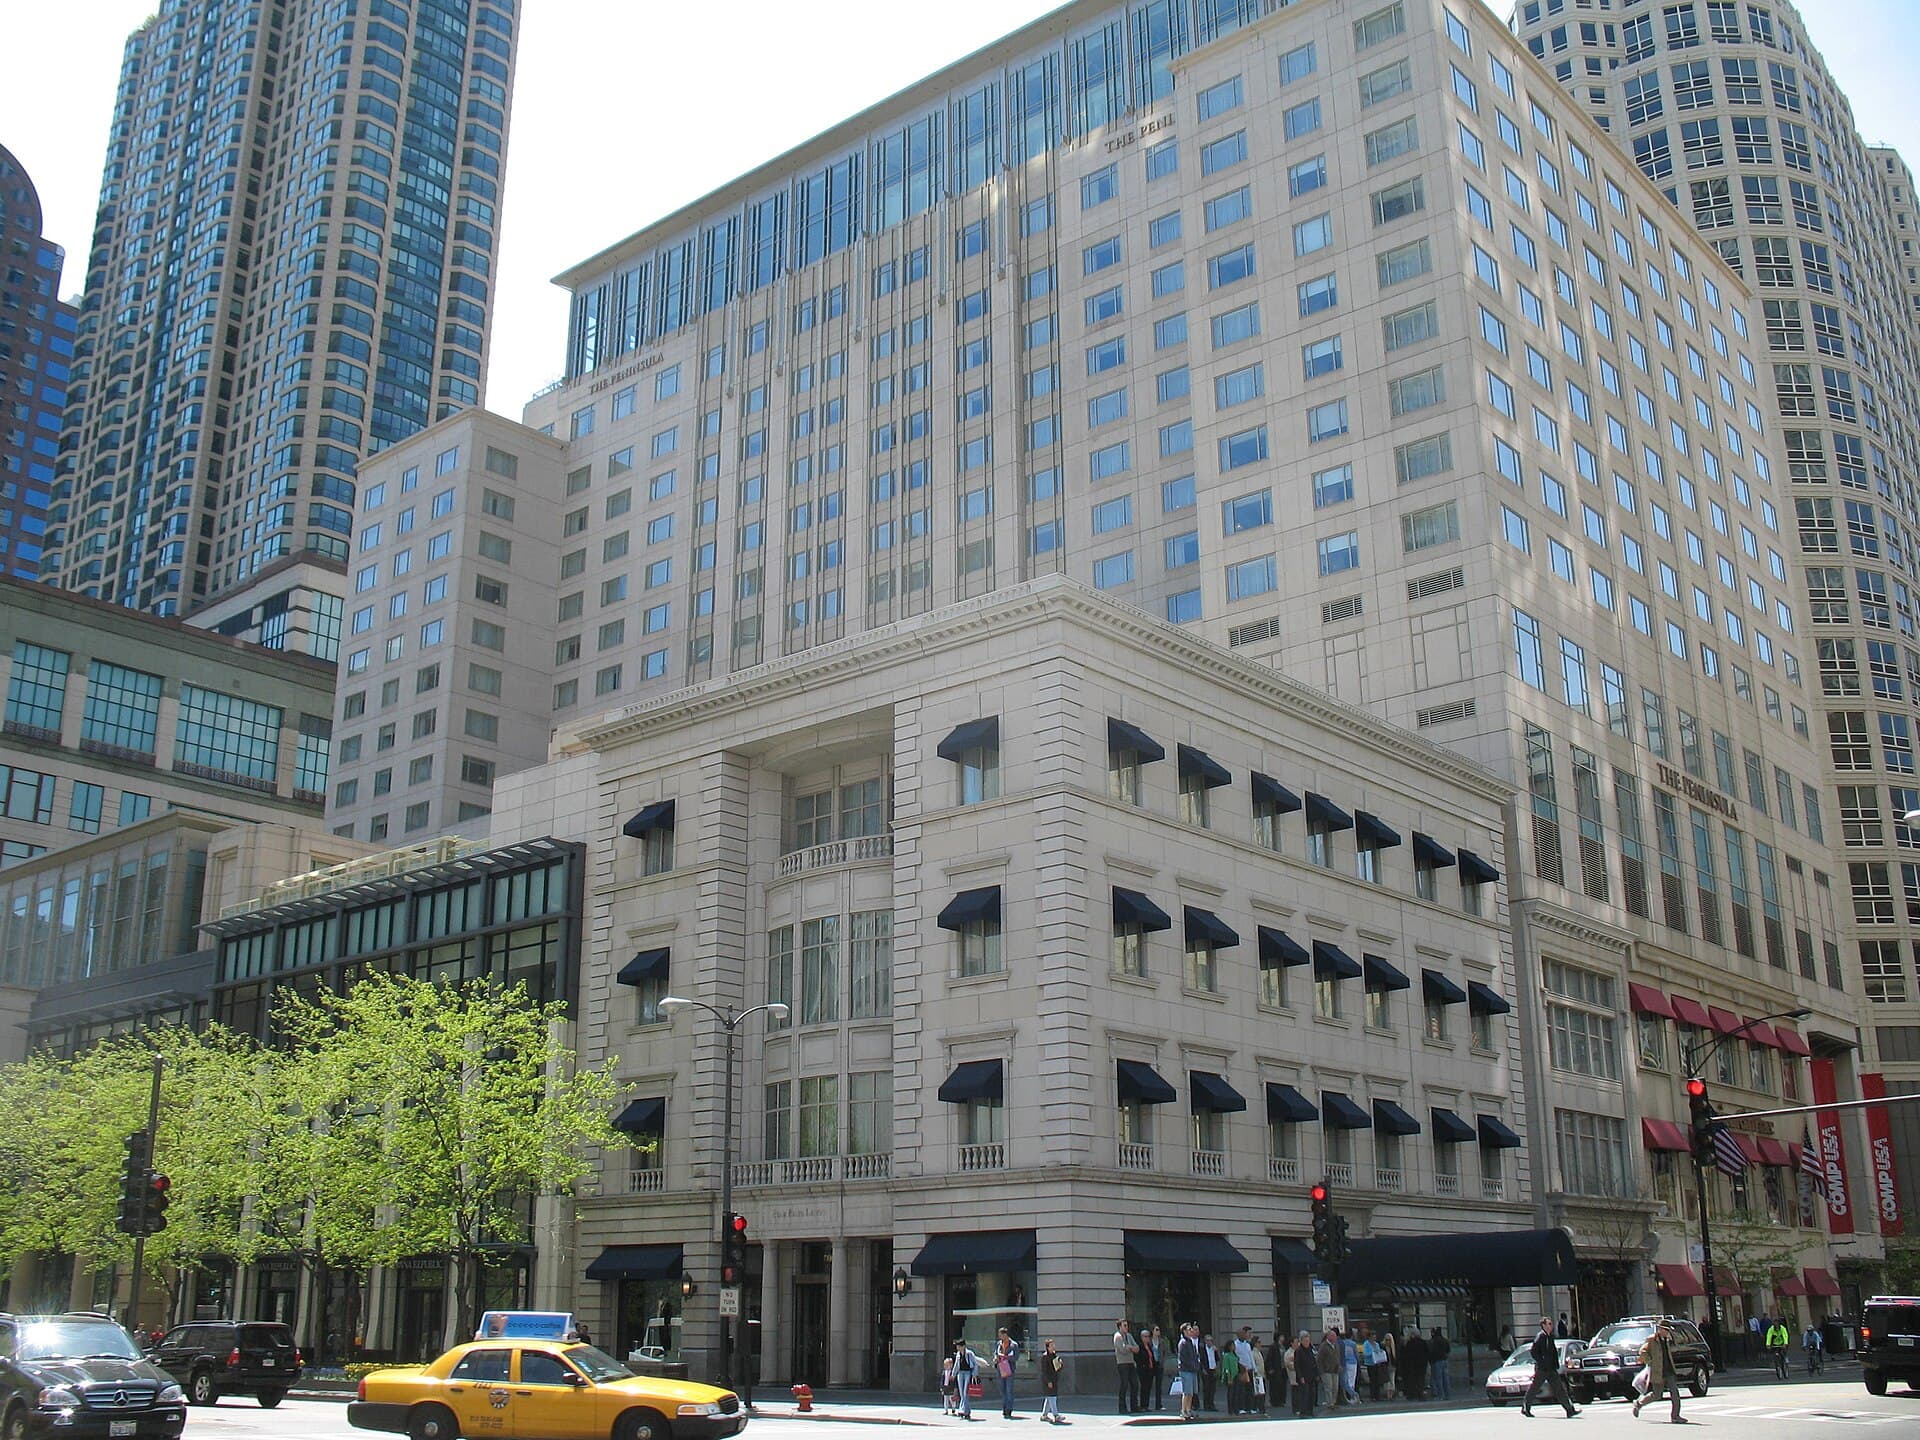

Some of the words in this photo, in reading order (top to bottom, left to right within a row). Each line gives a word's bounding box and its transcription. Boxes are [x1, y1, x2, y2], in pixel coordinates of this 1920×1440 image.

[1104, 131, 1135, 154] THE
[1139, 112, 1176, 139] PENI
[588, 378, 609, 395] THE
[609, 351, 665, 386] PENINSULA
[1656, 762, 1681, 792] THE
[1682, 775, 1739, 822] PENINSULA
[1873, 1137, 1898, 1222] COMPUSA
